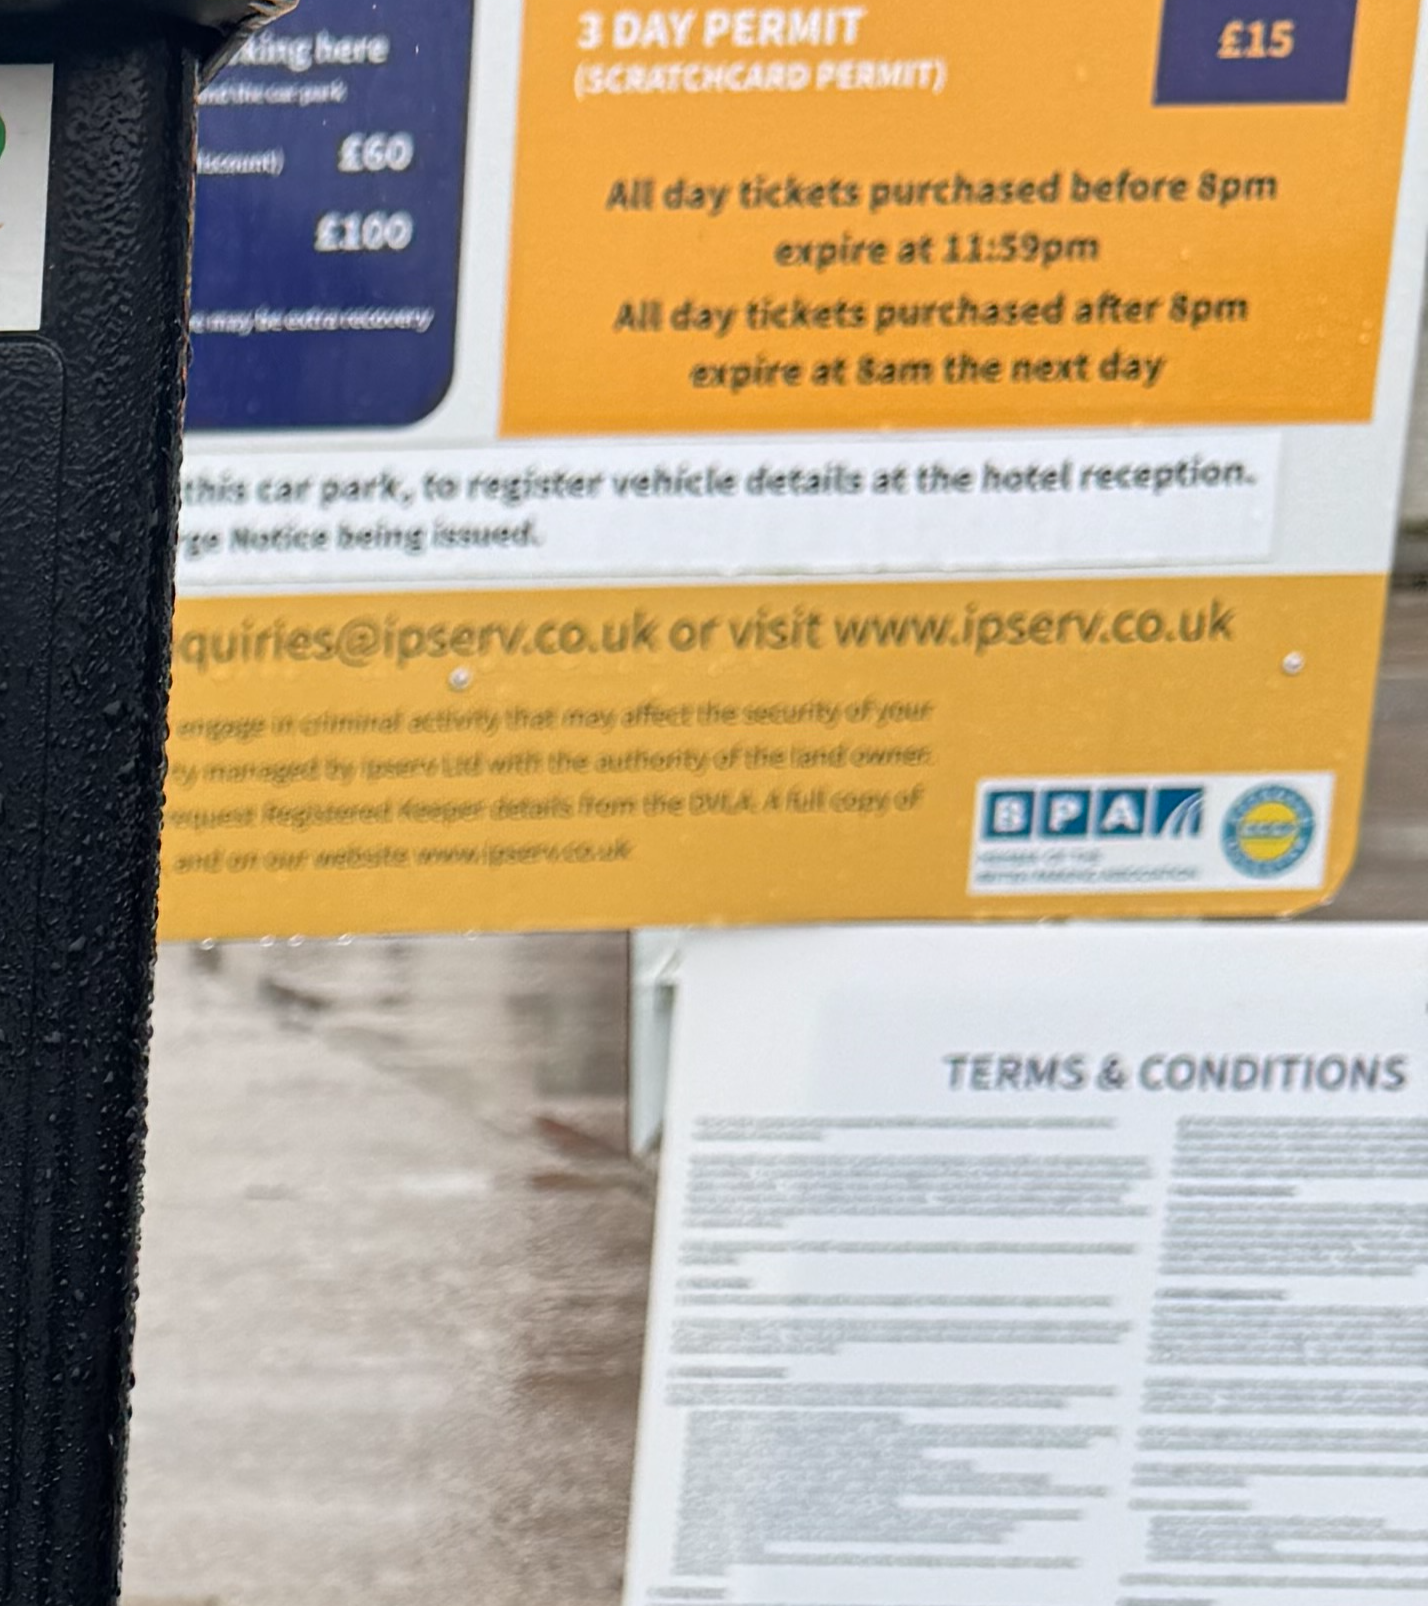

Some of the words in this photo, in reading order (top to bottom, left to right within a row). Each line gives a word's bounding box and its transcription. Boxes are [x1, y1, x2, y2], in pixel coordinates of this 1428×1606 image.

[578, 14, 602, 48] 3
[612, 11, 696, 48] DAY
[704, 5, 868, 46] PERMIT
[1218, 21, 1294, 58] £15
[316, 33, 390, 64] here
[573, 64, 808, 99] (SCRATCHCARD
[816, 59, 948, 93] PERMIT)
[338, 132, 414, 173] £60
[607, 180, 654, 212] All
[664, 177, 729, 217] day
[739, 174, 859, 208] tickets
[870, 173, 1059, 215] purchased
[1072, 171, 1188, 203] before
[1198, 173, 1278, 210] 8pm
[314, 212, 414, 252] £100
[775, 237, 886, 270] expire
[898, 235, 934, 263] at
[943, 232, 1099, 270] 11:59pm
[468, 466, 601, 506] register
[613, 463, 734, 498] vehicle
[916, 461, 975, 494] the
[982, 459, 1073, 493] hotel
[1080, 457, 1257, 496] reception.
[432, 521, 540, 550] issued.
[668, 616, 719, 648] or
[730, 607, 821, 650] visit
[836, 601, 1234, 653] www.ipserv.co.uk
[946, 1054, 1085, 1090] TERMS
[1097, 1054, 1125, 1090] &
[1138, 1052, 1407, 1091] CONDITIONS
